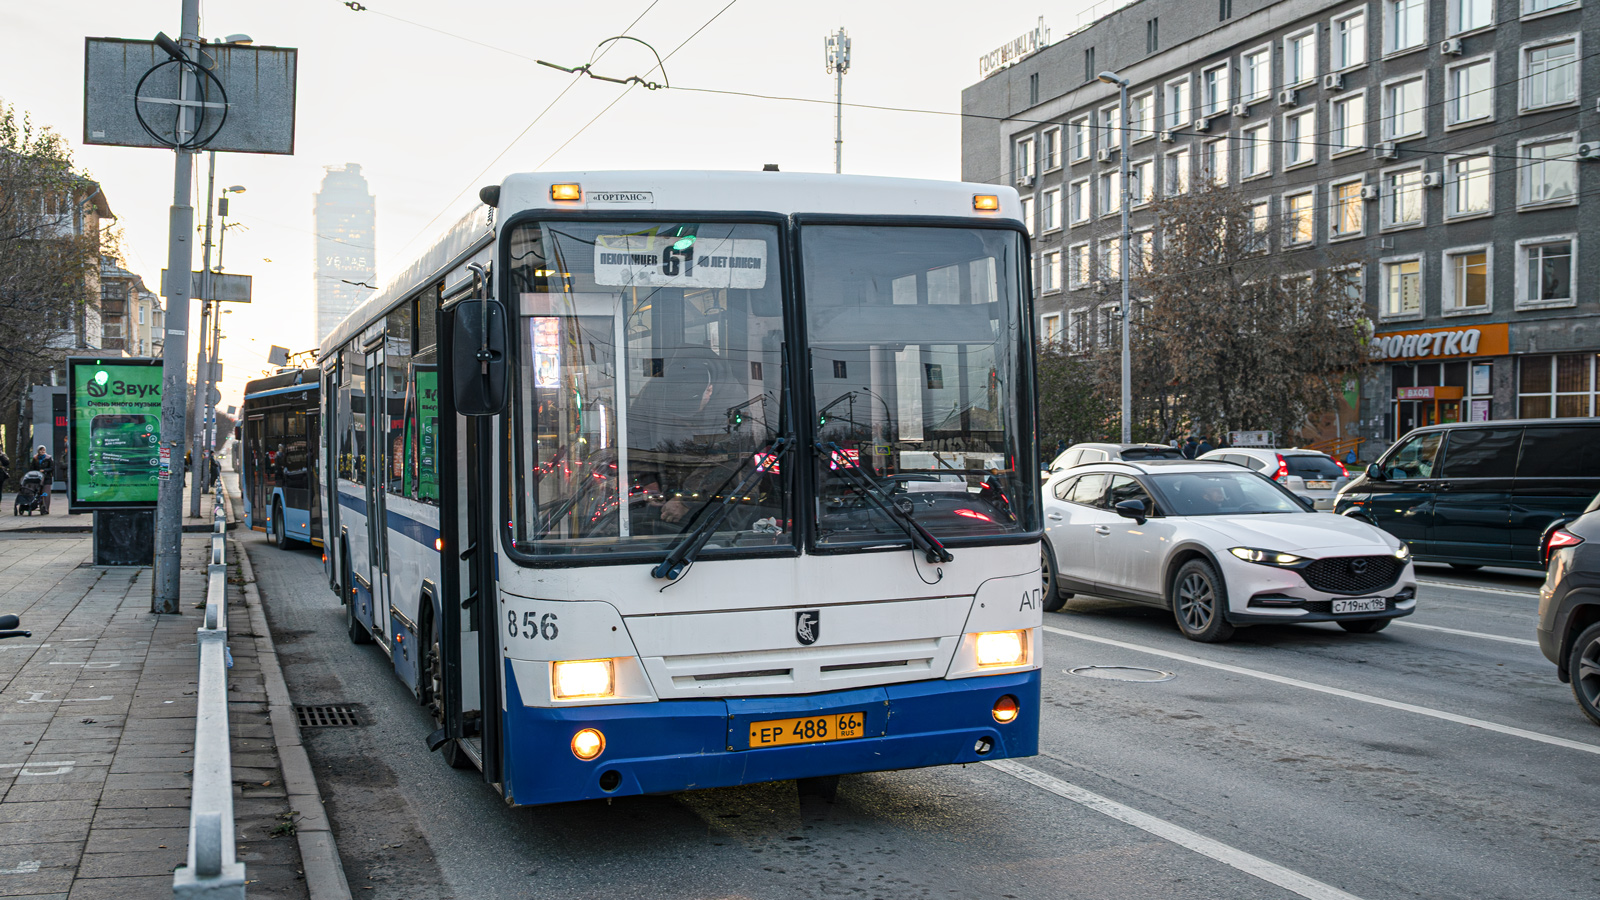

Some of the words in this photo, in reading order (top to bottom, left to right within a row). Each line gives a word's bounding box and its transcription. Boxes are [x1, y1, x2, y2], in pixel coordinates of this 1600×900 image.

[592, 193, 647, 202] «ГОРТРАНС»
[600, 252, 658, 266] ПЕХОТИНЦЕВ
[662, 245, 694, 277] 61
[710, 256, 728, 269] ЛЕТ
[728, 256, 762, 270] ВЛКСМ
[112, 380, 160, 398] Звук
[1407, 388, 1430, 398] ВХОД
[134, 401, 162, 409] музыки
[508, 610, 559, 641] 856
[792, 719, 828, 740] 488
[839, 715, 856, 730] 66
